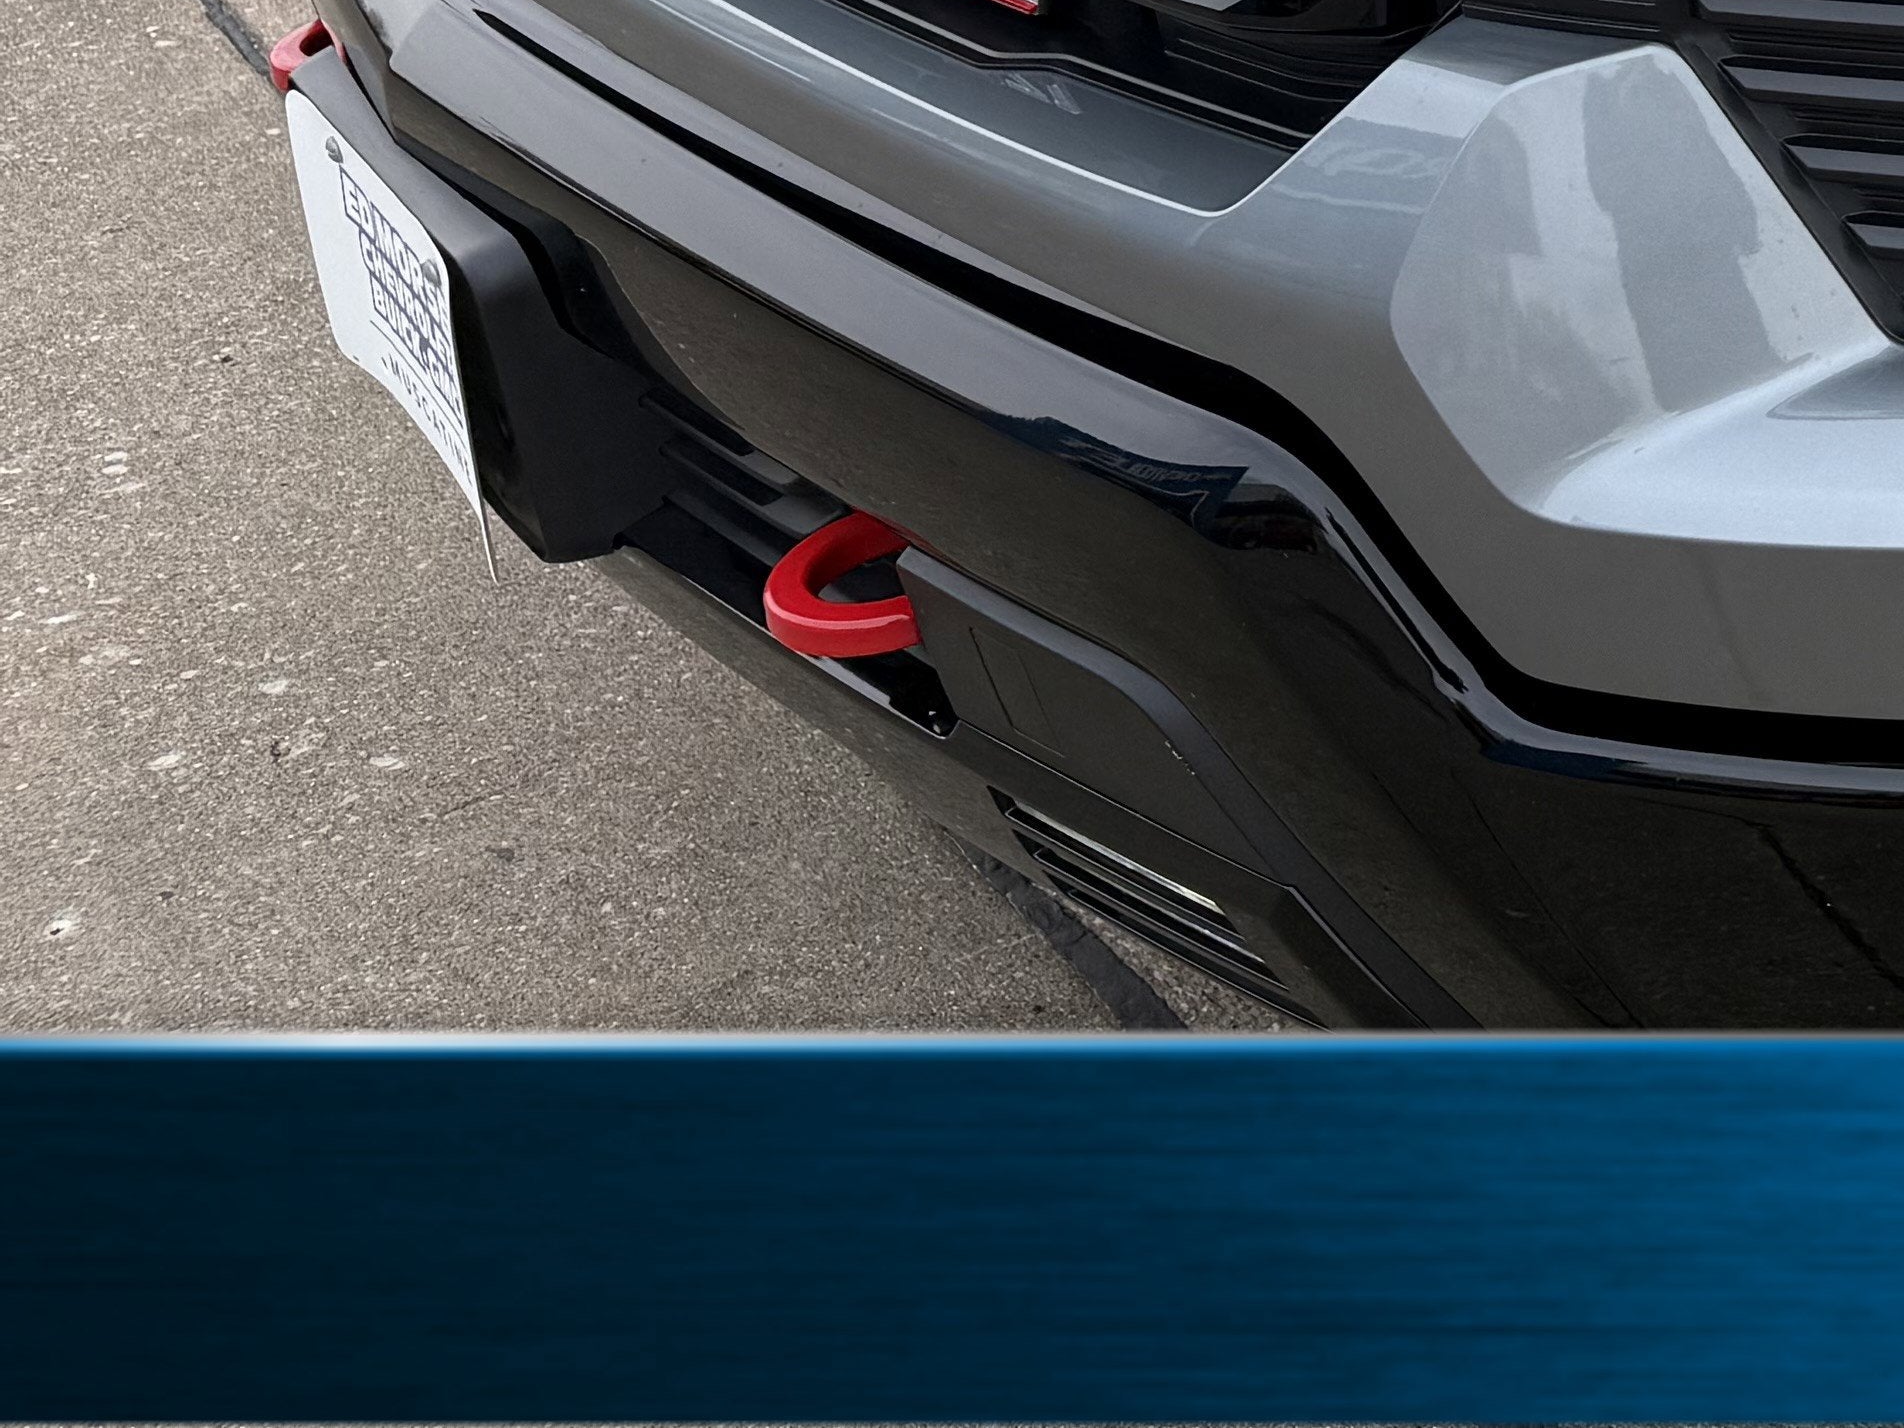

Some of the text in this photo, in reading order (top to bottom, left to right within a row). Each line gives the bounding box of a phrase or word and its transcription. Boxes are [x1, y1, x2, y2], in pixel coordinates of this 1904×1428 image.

[338, 164, 451, 346] ED MORSE
[357, 227, 454, 378] CHEVROLET
